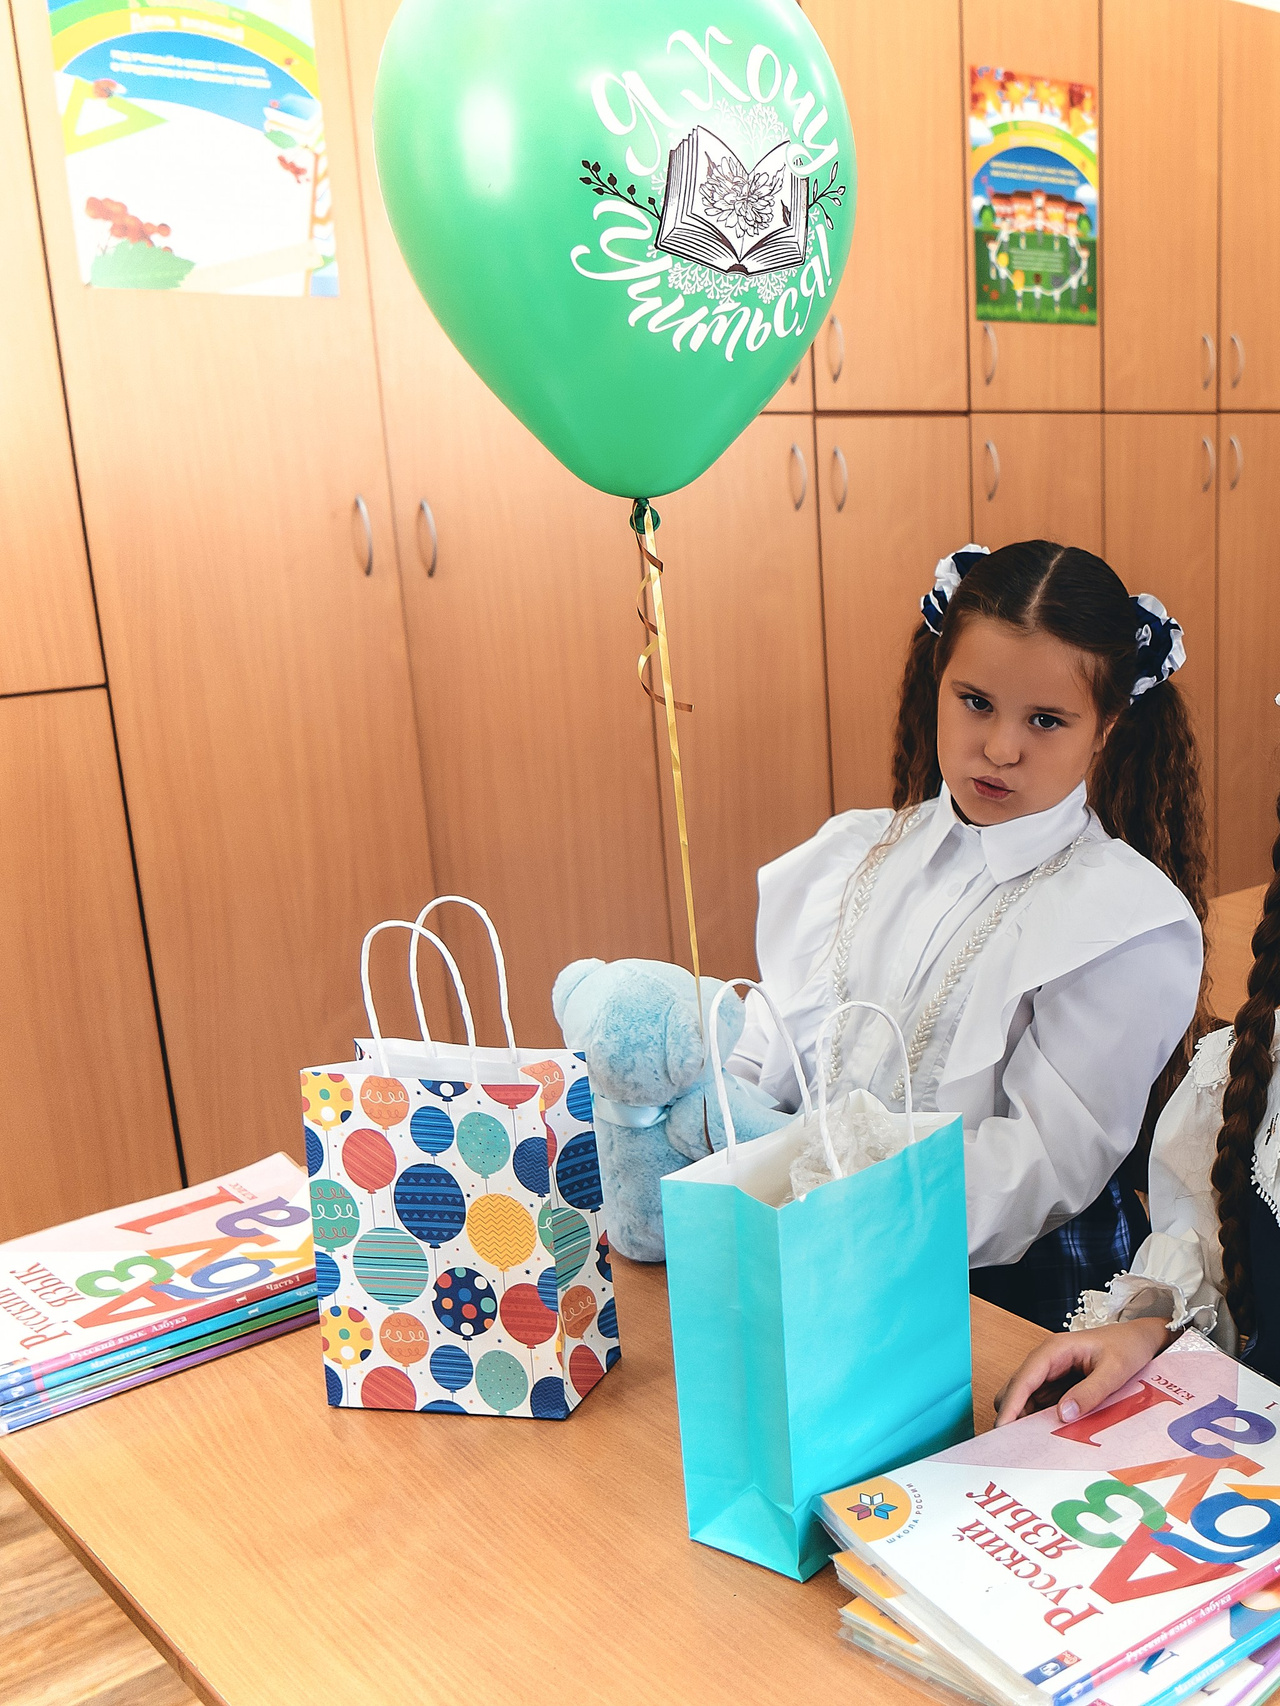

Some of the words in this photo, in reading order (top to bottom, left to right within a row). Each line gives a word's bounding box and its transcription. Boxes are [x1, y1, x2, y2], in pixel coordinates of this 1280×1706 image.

[114, 1185, 245, 1235] 1
[151, 1315, 188, 1333] Азбука
[265, 1279, 294, 1291] Часть
[1050, 1379, 1185, 1448] 1
[886, 1519, 920, 1544] ШКОЛА
[905, 1483, 924, 1515] РОССИИ
[1199, 1594, 1232, 1618] Азбука
